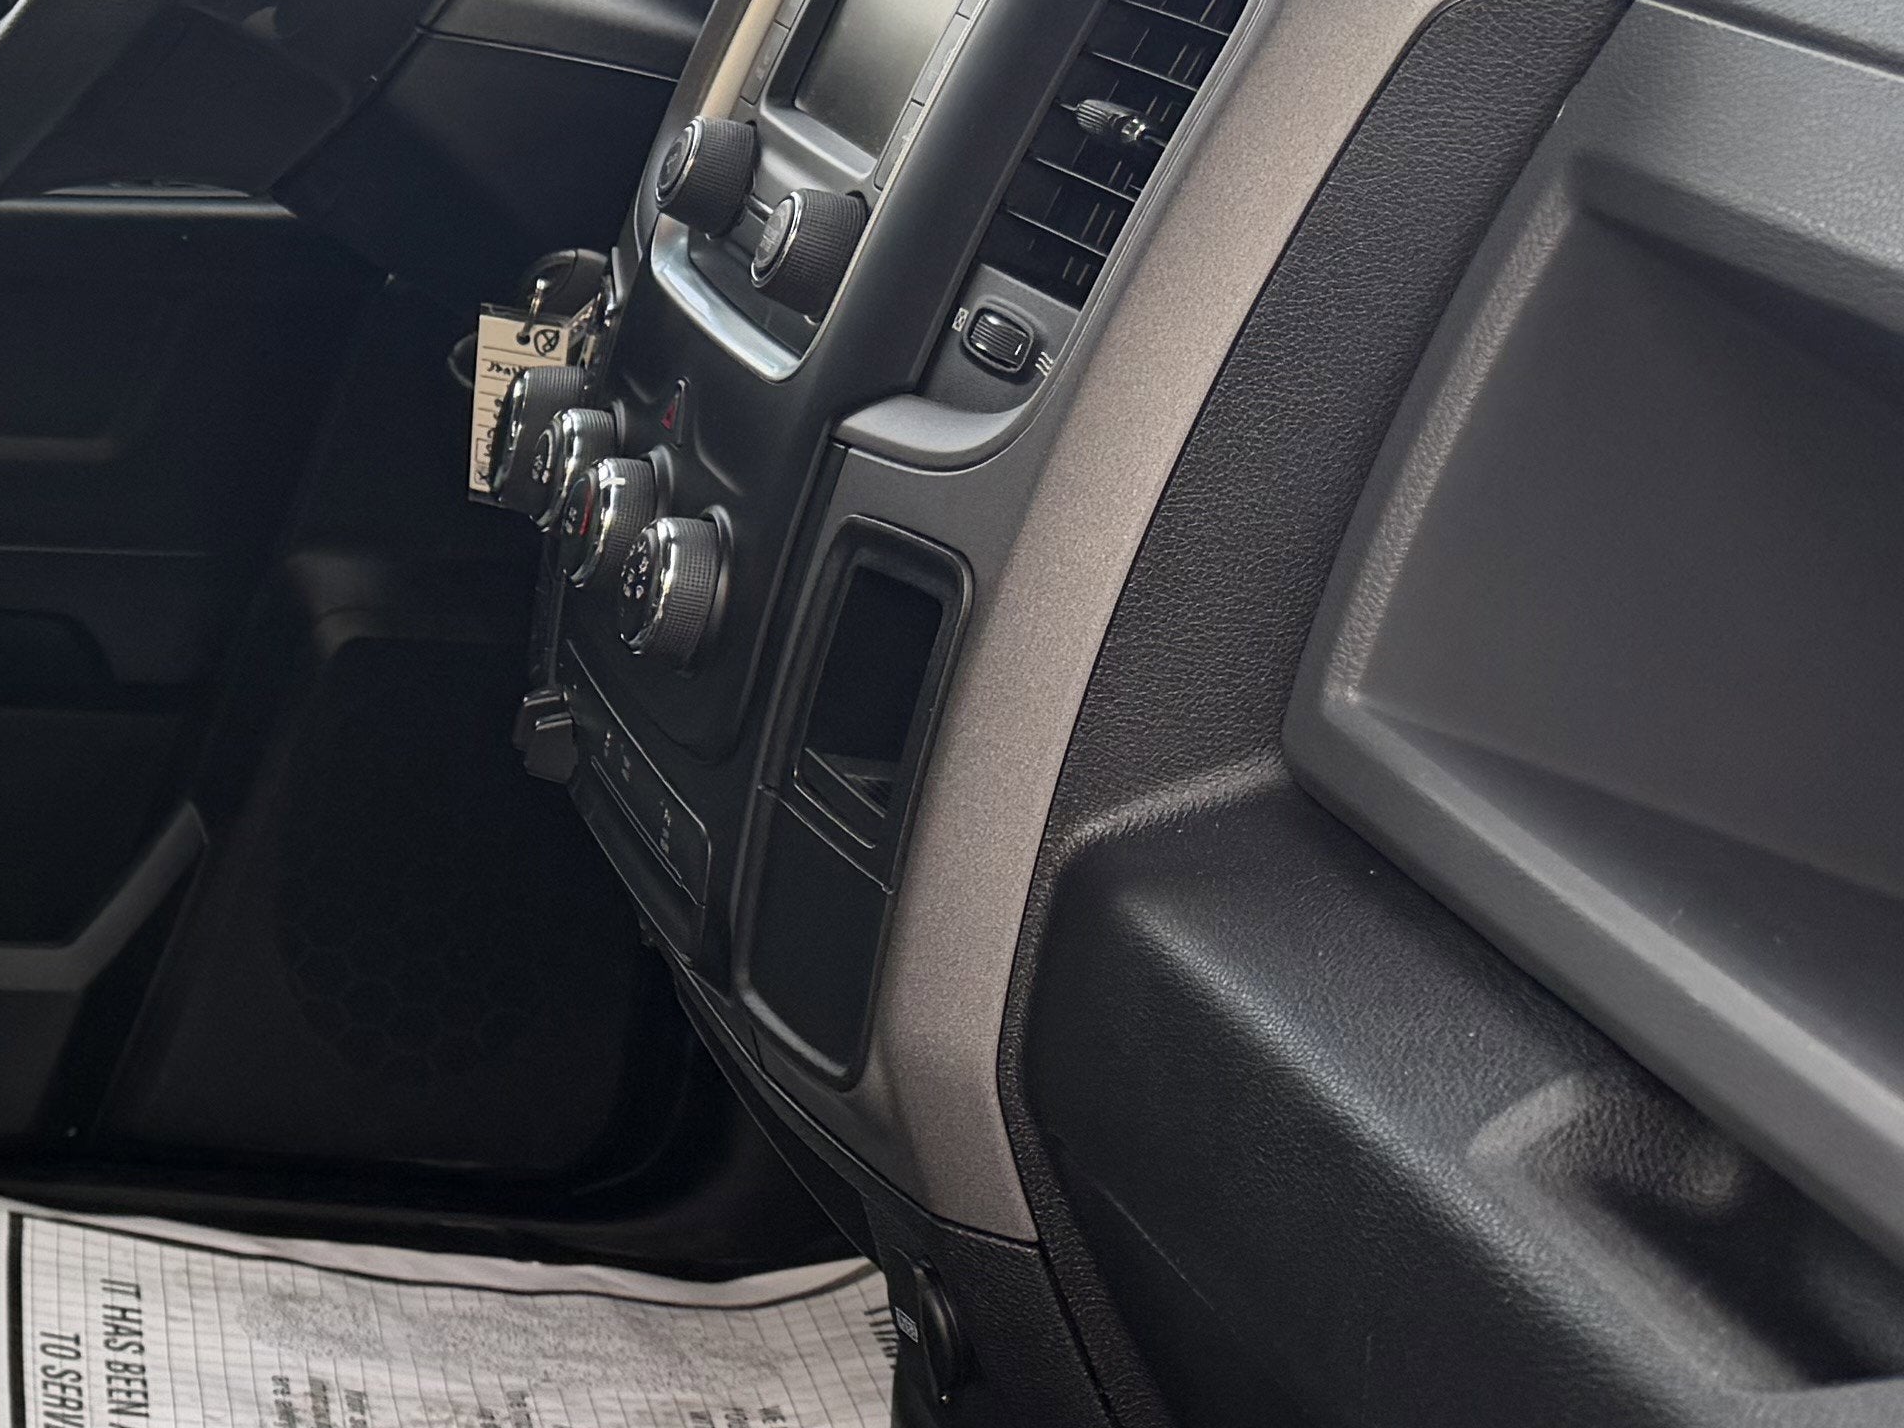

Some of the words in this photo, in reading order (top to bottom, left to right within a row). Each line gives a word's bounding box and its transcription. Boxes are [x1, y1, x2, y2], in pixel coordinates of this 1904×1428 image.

[101, 1279, 141, 1300] IT
[40, 1332, 81, 1360] TO
[102, 1305, 144, 1355] HAS
[105, 1360, 150, 1418] BEEN
